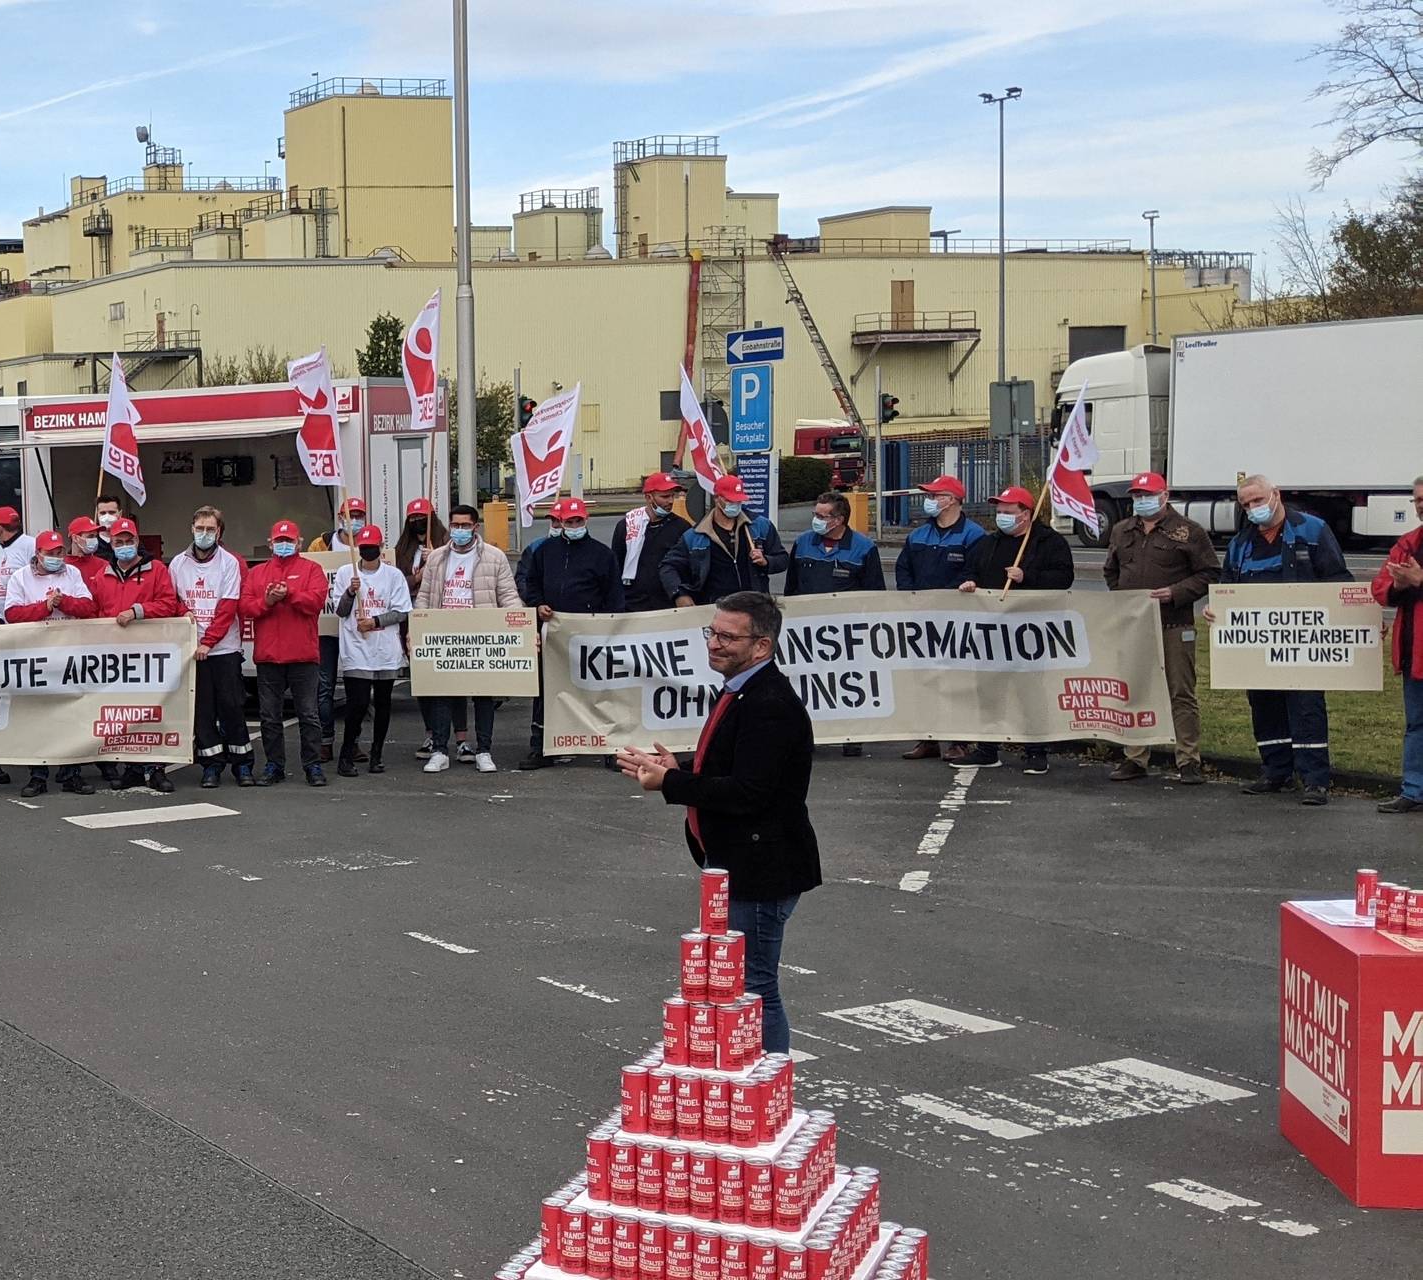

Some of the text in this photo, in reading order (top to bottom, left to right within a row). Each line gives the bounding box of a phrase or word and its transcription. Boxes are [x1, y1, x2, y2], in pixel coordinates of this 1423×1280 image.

[741, 339, 782, 352] Einbahnstraße
[740, 372, 761, 417] P
[33, 412, 76, 429] BEZIRK
[373, 414, 395, 432] BEZIRK
[735, 421, 766, 431] Besucher
[735, 432, 765, 444] Parkplatz
[185, 589, 218, 600] WANDEL
[1230, 610, 1325, 627] MIT GUTER
[424, 634, 522, 646] UNVERHANDELBAR:
[1218, 628, 1374, 645] INDUSTRIEARBEIT.
[415, 647, 506, 658] GUTE ARBEIT UND
[1269, 647, 1350, 663] MIT UNS!
[436, 659, 533, 670] SOZIALER SCHUTZ!
[579, 638, 694, 682] KEINE
[62, 652, 171, 686] ARBEIT
[1068, 679, 1126, 699] WANDEL
[1062, 694, 1095, 709] FAIR
[104, 707, 159, 721] WANDEL
[1078, 708, 1131, 726] GESTALTEN
[96, 722, 124, 735] FAIR
[107, 734, 160, 745] GESTALTEN
[552, 734, 607, 748] IGBCE.DE
[1284, 1003, 1351, 1097] MACHEN.
[718, 1186, 733, 1196] FAIR
[748, 1191, 763, 1200] FAIR
[775, 1194, 789, 1204] FAIR
